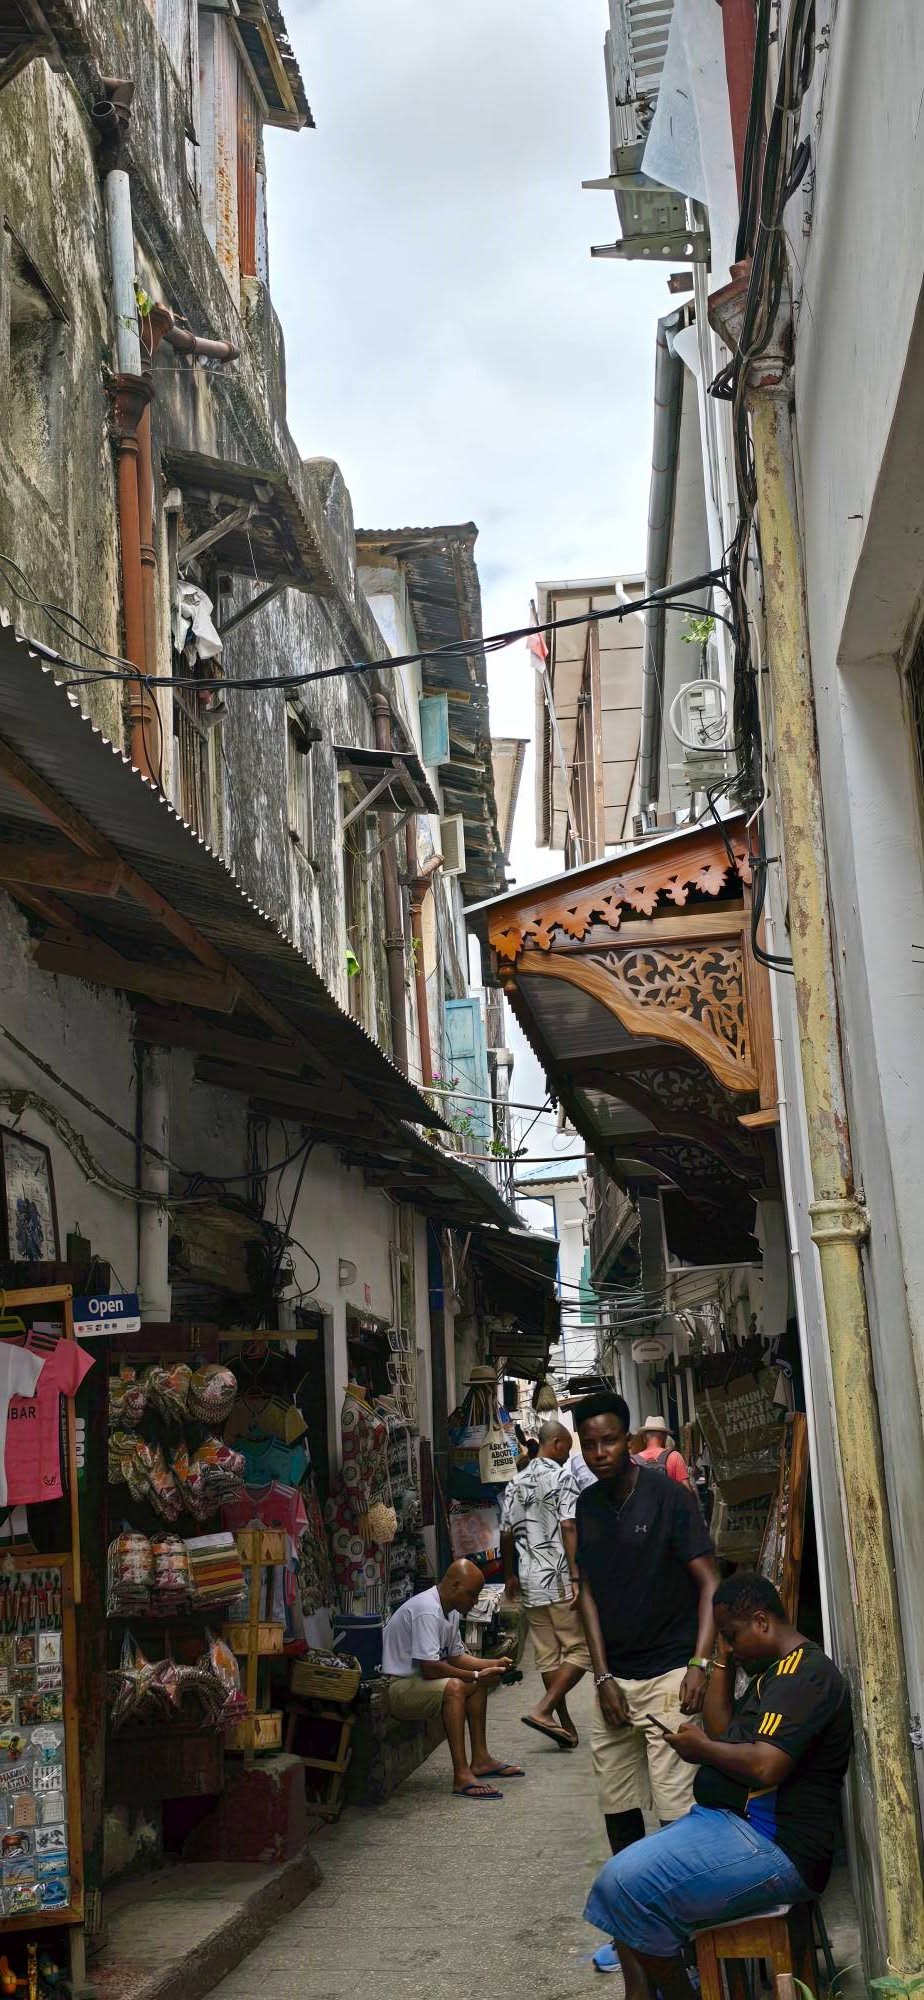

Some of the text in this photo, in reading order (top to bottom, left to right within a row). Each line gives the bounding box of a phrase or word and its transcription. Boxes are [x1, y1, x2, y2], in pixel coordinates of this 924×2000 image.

[88, 1298, 124, 1318] Open
[724, 1388, 768, 1411] HAKUNA
[491, 1450, 511, 1458] ABOUT
[493, 1458, 513, 1466] JESUS
